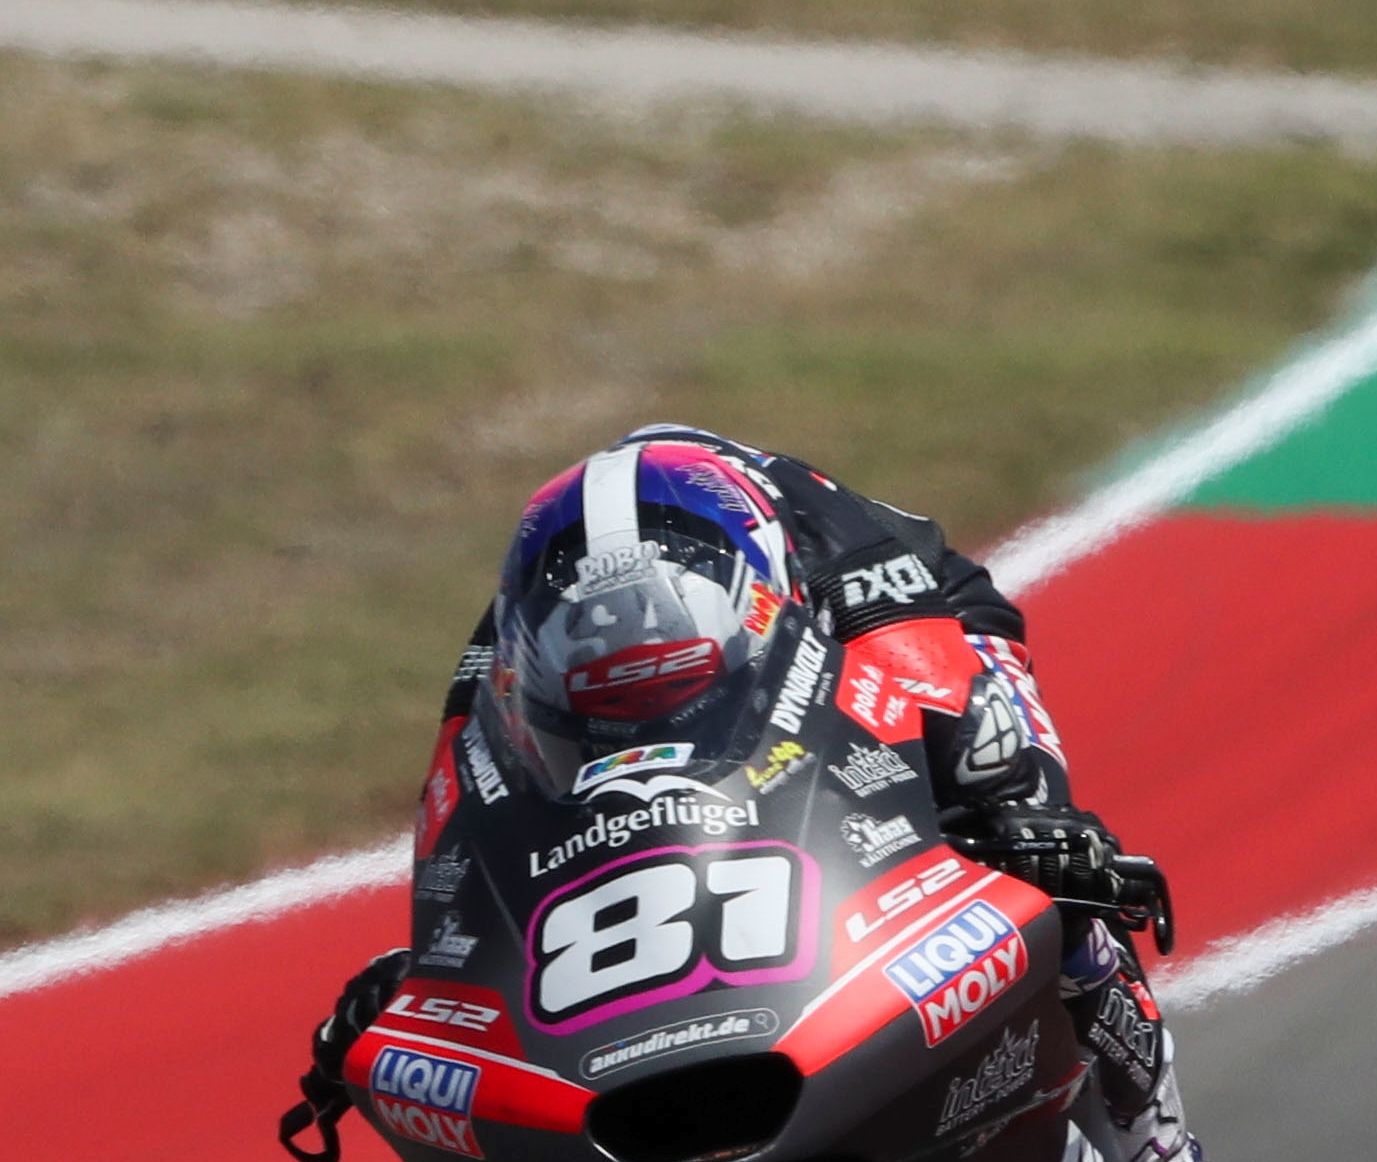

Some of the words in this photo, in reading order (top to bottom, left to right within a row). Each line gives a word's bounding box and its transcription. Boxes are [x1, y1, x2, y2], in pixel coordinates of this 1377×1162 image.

[568, 641, 713, 692] LS2
[770, 626, 828, 735] DYNAVOLT
[529, 796, 760, 879] Landgeflügel
[540, 855, 792, 1014] 81
[845, 858, 967, 943] LS2
[891, 904, 1007, 999] LIQUI
[928, 942, 1026, 1040] MOLY
[384, 994, 501, 1032] LS2
[589, 1015, 751, 1074] akkudirekt.de
[375, 1051, 474, 1111] LIQUI
[376, 1097, 471, 1152] MOLY
